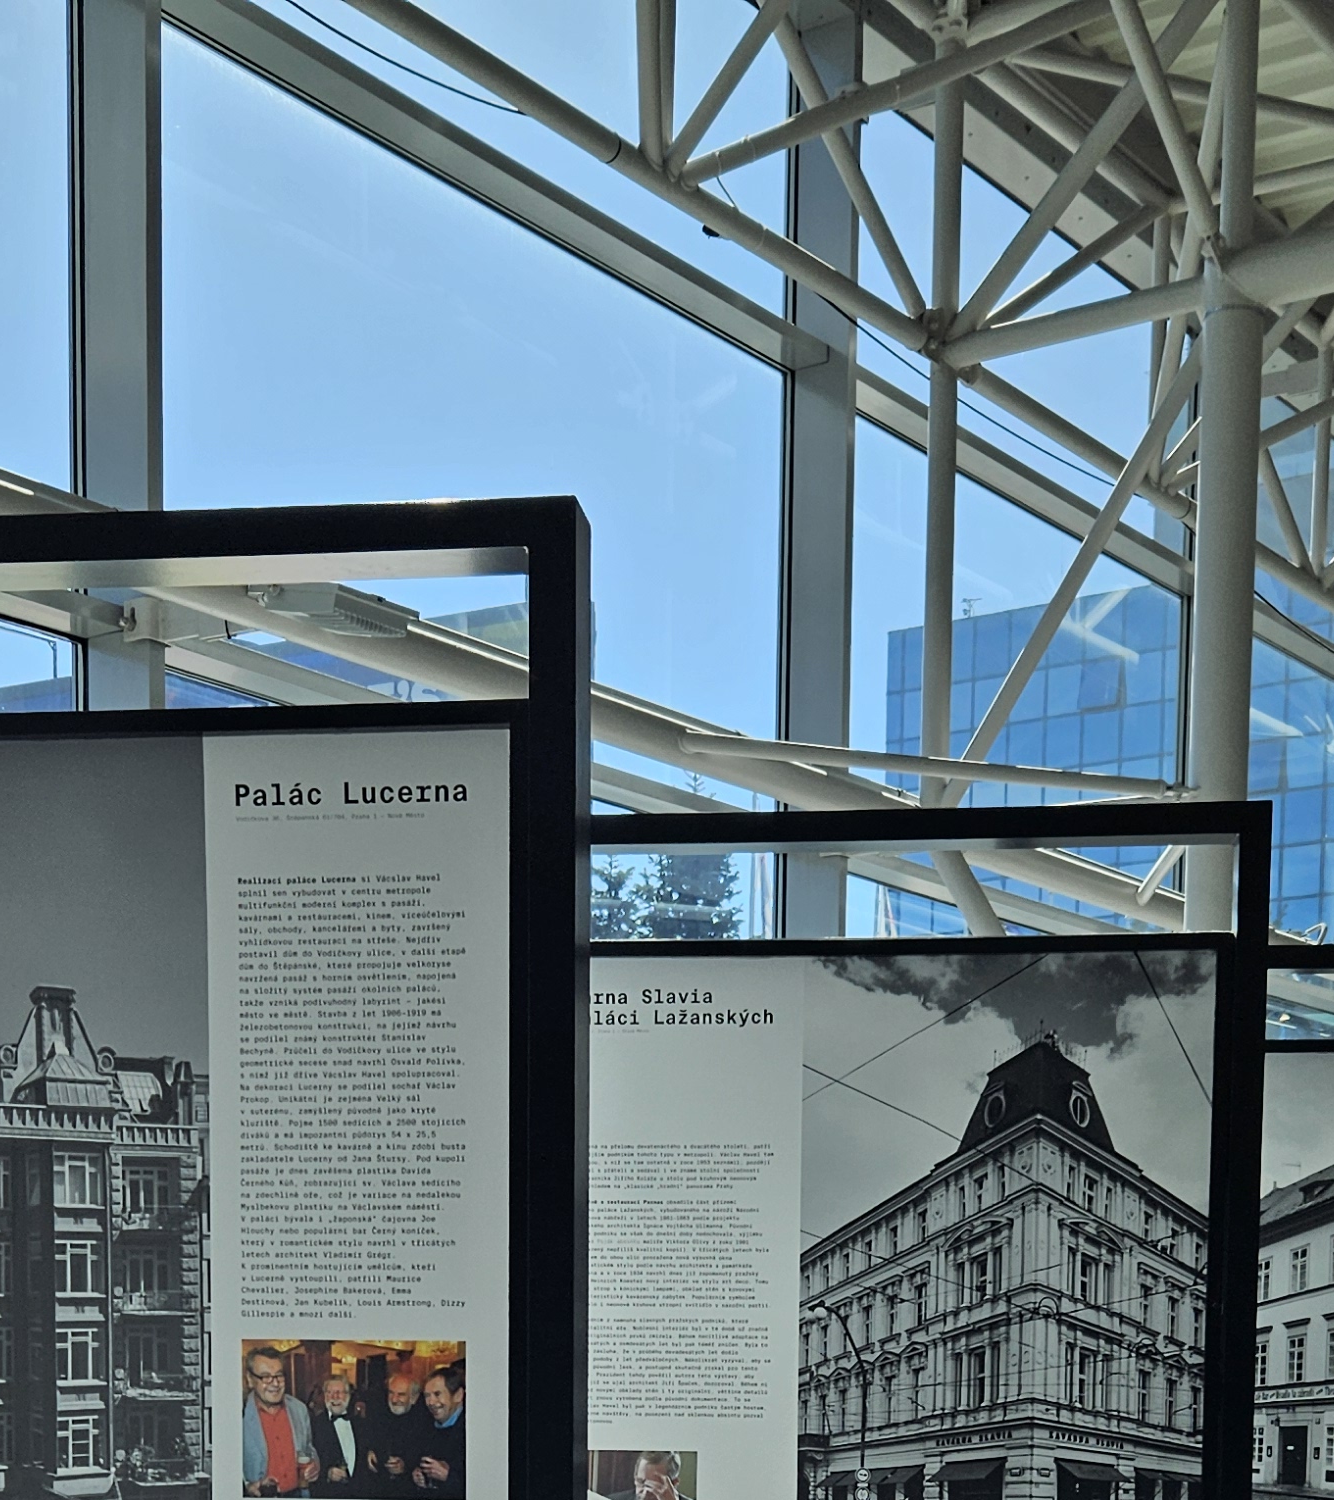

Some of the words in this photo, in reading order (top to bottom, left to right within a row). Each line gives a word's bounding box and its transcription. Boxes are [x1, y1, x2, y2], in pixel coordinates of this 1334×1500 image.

[234, 782, 323, 807] Palác
[343, 781, 469, 805] Lucerna
[590, 992, 628, 1005] rna
[641, 988, 713, 1005] Slavia
[589, 1010, 641, 1026] láci
[653, 1008, 775, 1028] Lažanských
